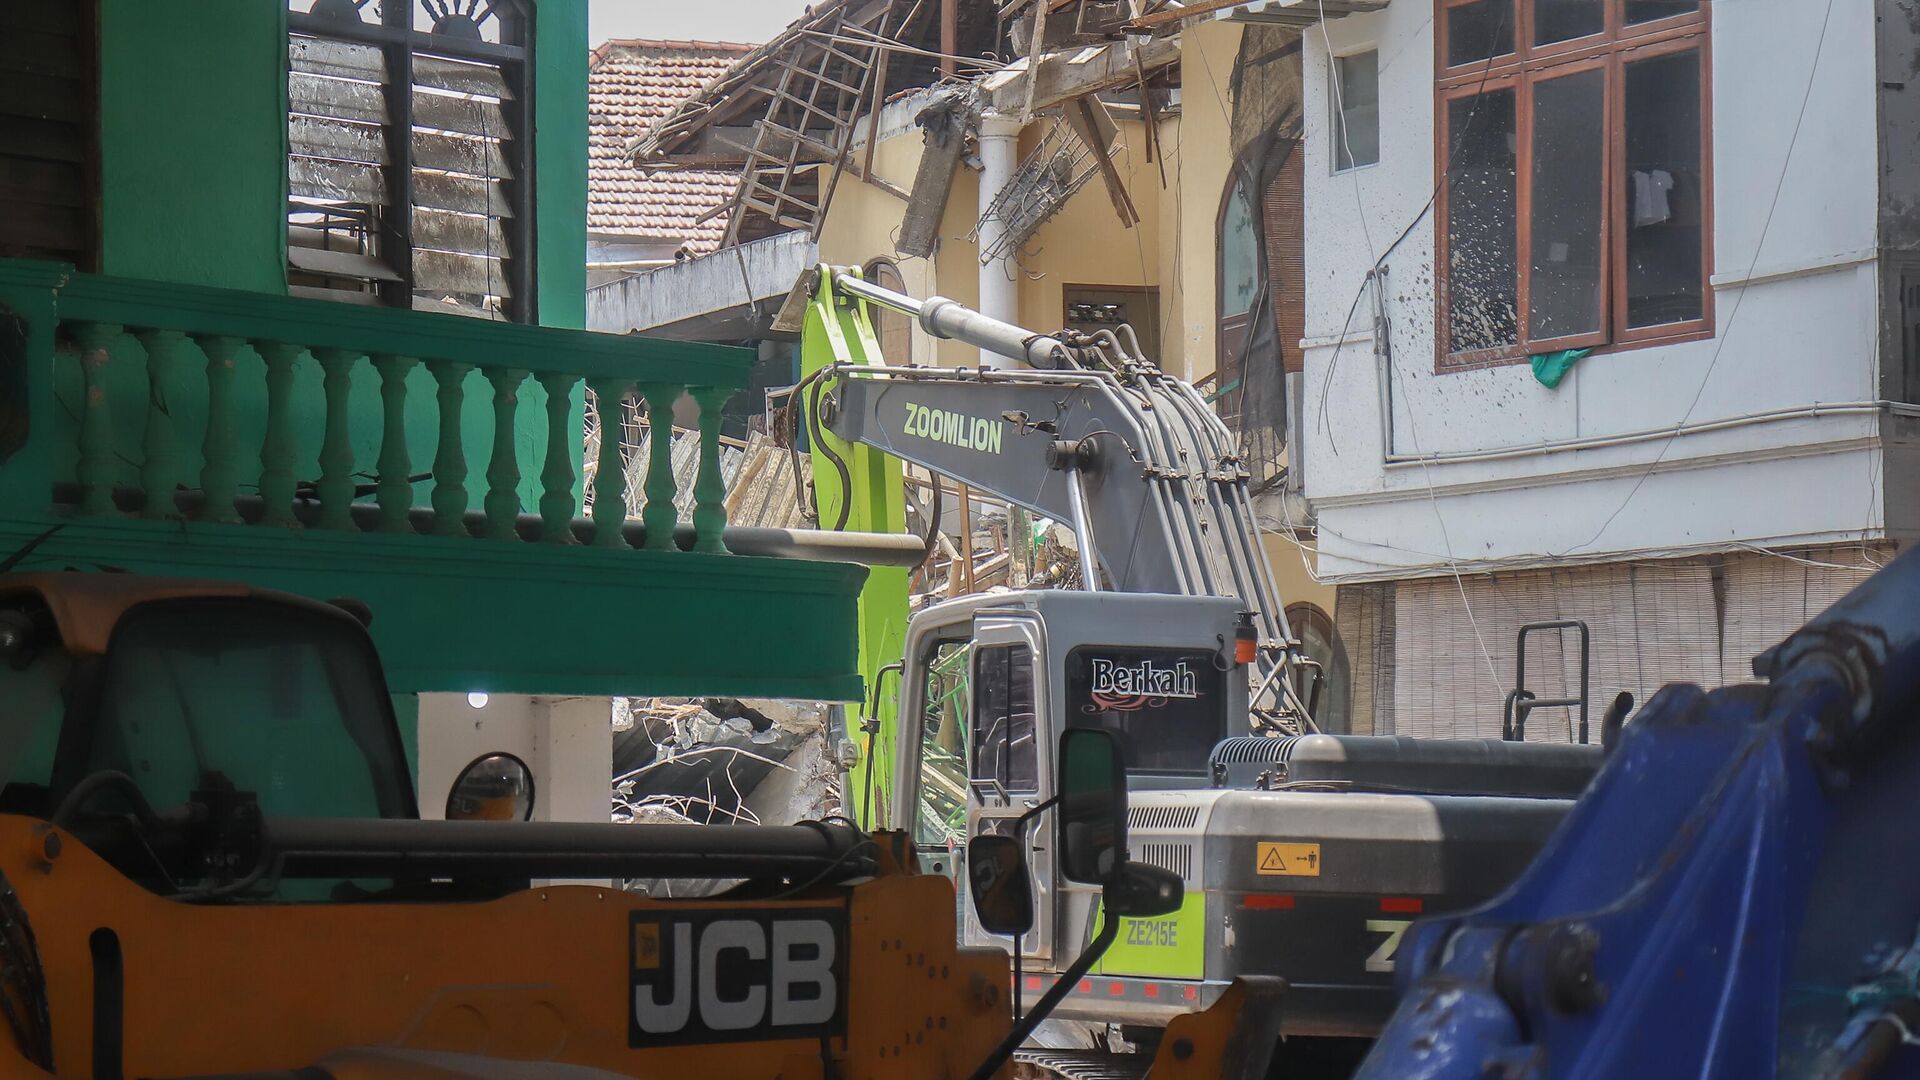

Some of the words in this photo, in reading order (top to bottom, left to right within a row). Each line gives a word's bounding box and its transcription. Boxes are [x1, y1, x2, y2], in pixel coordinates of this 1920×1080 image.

[904, 402, 1002, 454] ZOOMLION
[1092, 659, 1197, 698] Berkah
[1127, 920, 1177, 946] ZE215E
[635, 919, 837, 1033] JCB
